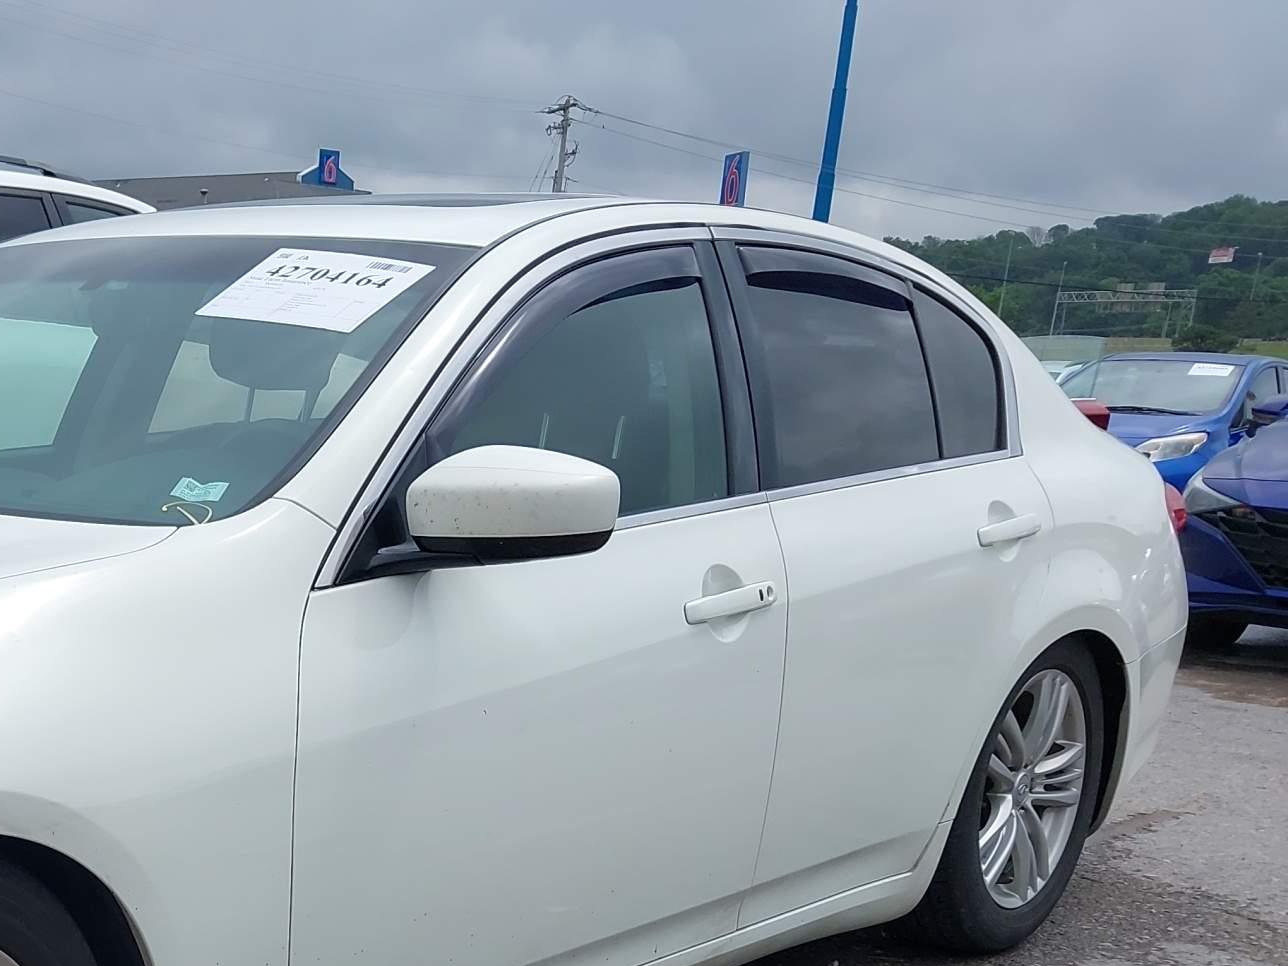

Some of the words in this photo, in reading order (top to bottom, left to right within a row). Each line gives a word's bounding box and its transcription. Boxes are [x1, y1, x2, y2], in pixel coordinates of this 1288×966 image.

[324, 155, 337, 183] 6
[724, 154, 740, 205] 6
[266, 264, 394, 289] 42704164
